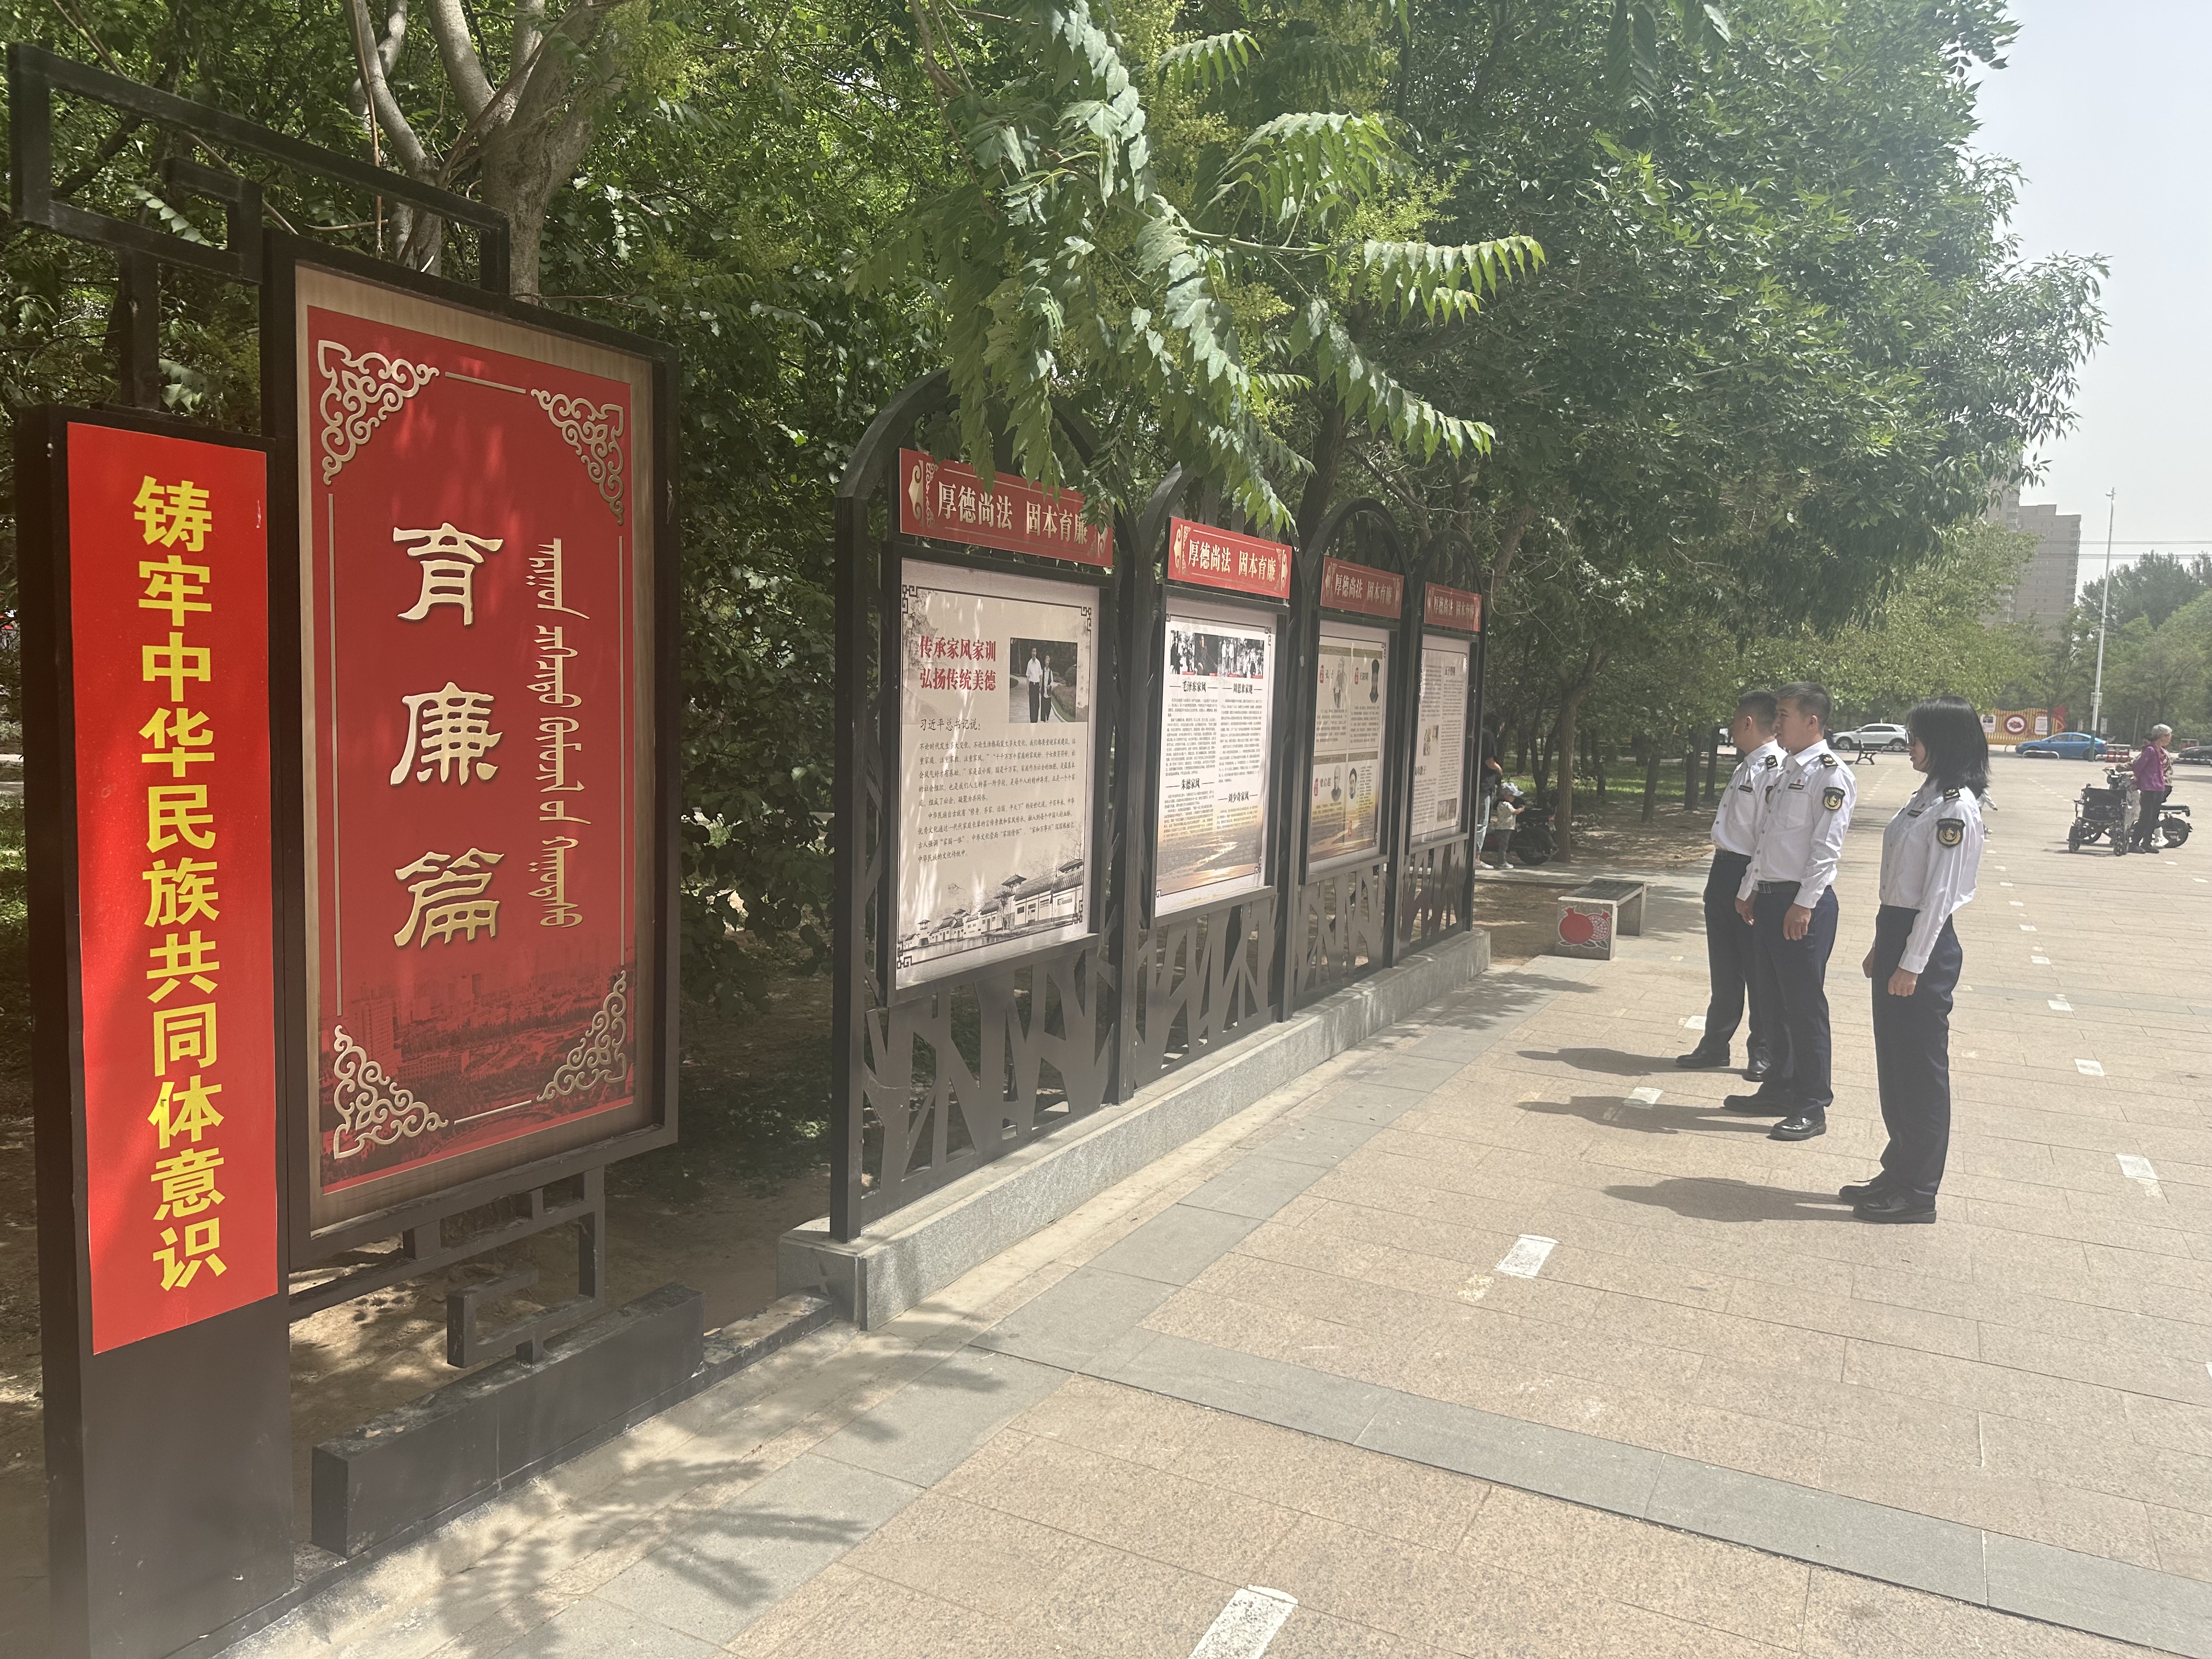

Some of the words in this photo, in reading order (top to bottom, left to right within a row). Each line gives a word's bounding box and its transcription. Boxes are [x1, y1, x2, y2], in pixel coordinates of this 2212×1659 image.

[938, 481, 1013, 531] 厚德尚法
[1025, 500, 1088, 545] 固本育廉
[1188, 539, 1231, 573] 厚德尚法
[1238, 550, 1276, 583] 固本育廉
[1334, 573, 1363, 599] 厚德尚法
[1367, 580, 1392, 605] 固本育廉
[919, 635, 997, 662] 传承家风家训
[919, 667, 996, 691] 弘扬传统美德
[1182, 680, 1206, 692] 毛泽东家风
[390, 522, 505, 949] 育廉篇
[920, 718, 980, 732] 习近平总书记说：
[1181, 778, 1200, 790] 朱德家风
[1228, 791, 1249, 803] 刘少奇家风
[133, 475, 227, 1291] 铸牢中华民族共同体意识
